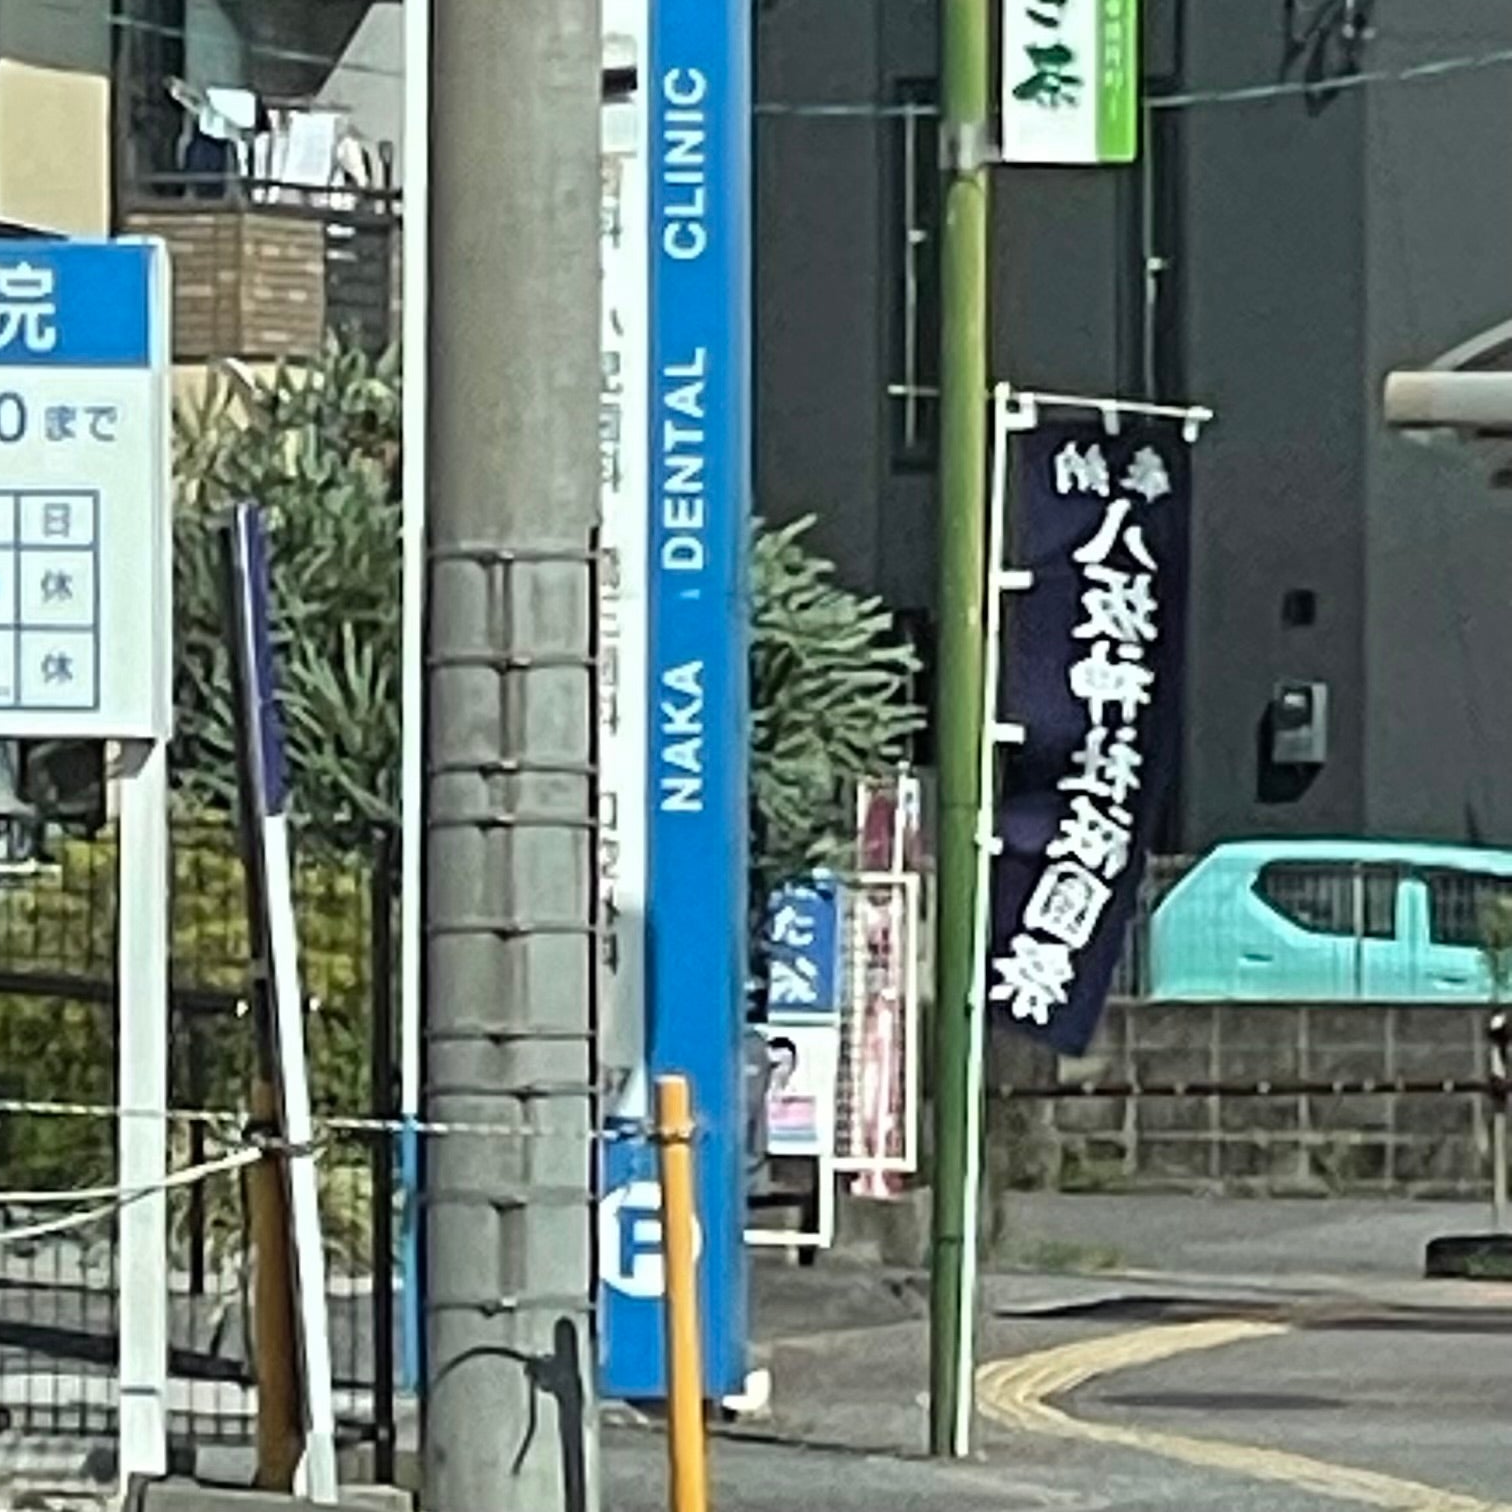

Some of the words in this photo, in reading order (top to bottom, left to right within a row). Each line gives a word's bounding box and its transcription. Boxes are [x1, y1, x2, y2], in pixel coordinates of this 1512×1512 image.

[663, 67, 707, 260] CLINIC
[44, 404, 118, 442] まで
[663, 346, 706, 571] DENTAL
[42, 502, 72, 538] 日
[40, 568, 74, 603] 休
[40, 650, 75, 685] 休
[661, 659, 705, 812] NAKA
